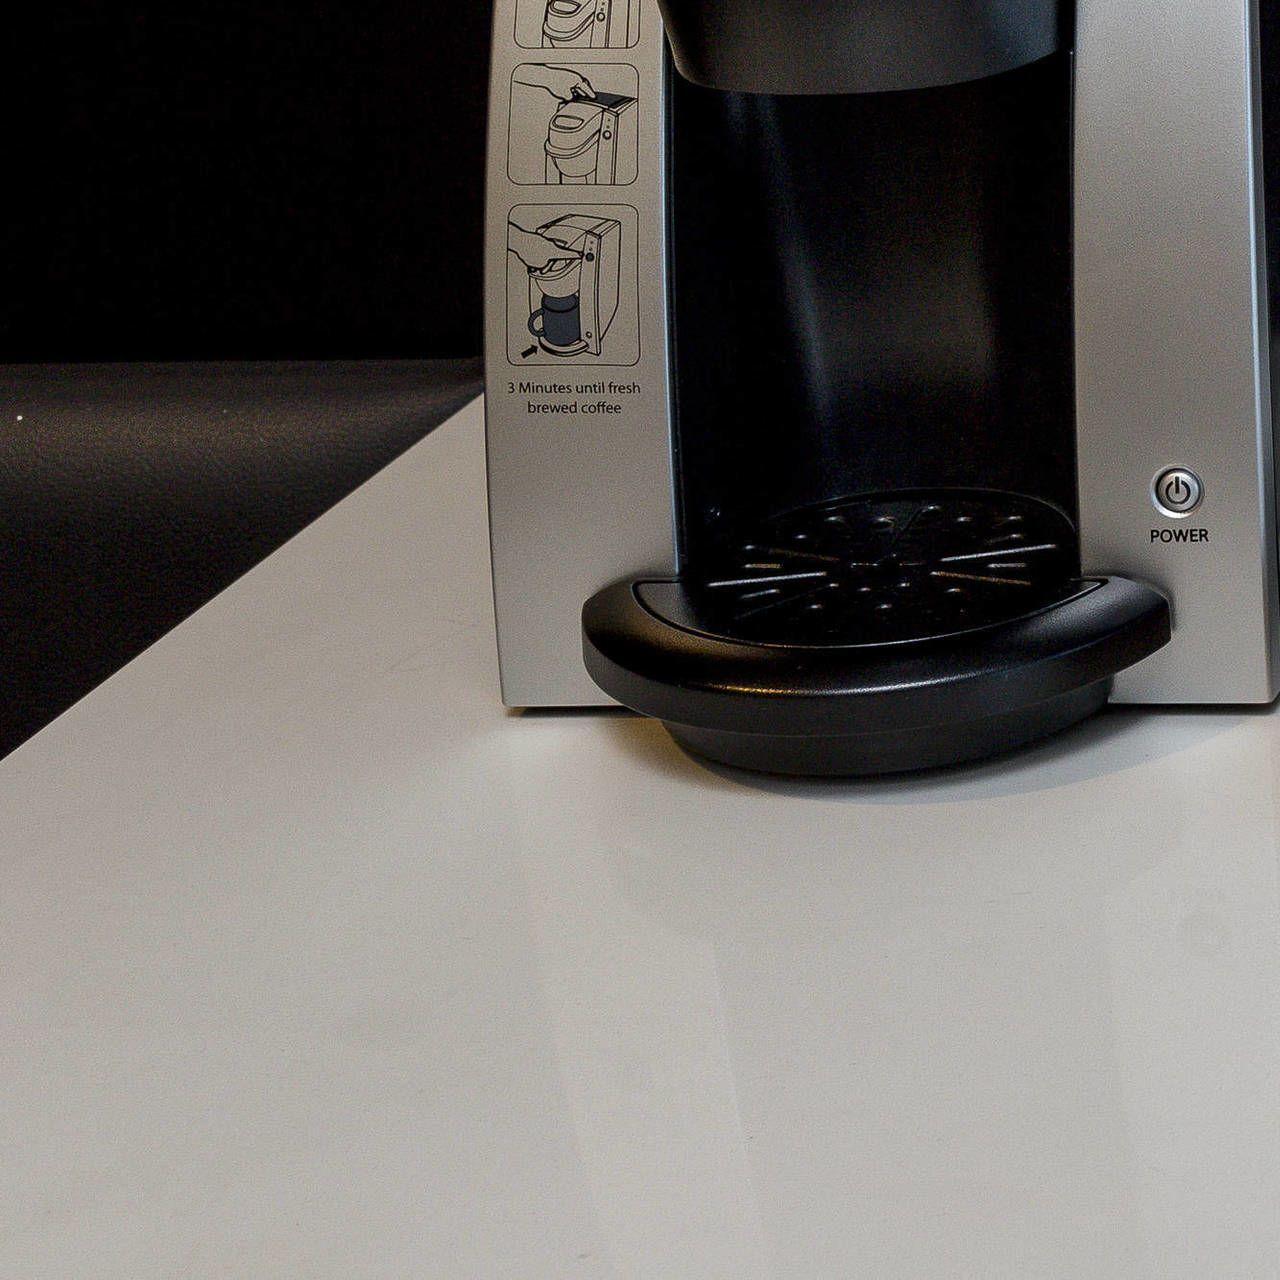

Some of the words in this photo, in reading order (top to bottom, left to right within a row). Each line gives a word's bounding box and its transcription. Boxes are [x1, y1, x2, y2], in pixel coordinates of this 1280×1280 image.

[507, 382, 515, 394] 3
[519, 382, 572, 394] Minutes
[575, 382, 605, 394] until
[608, 381, 640, 394] fresh
[527, 400, 577, 414] brewed
[581, 401, 622, 414] coffee
[1150, 529, 1209, 543] POWER
